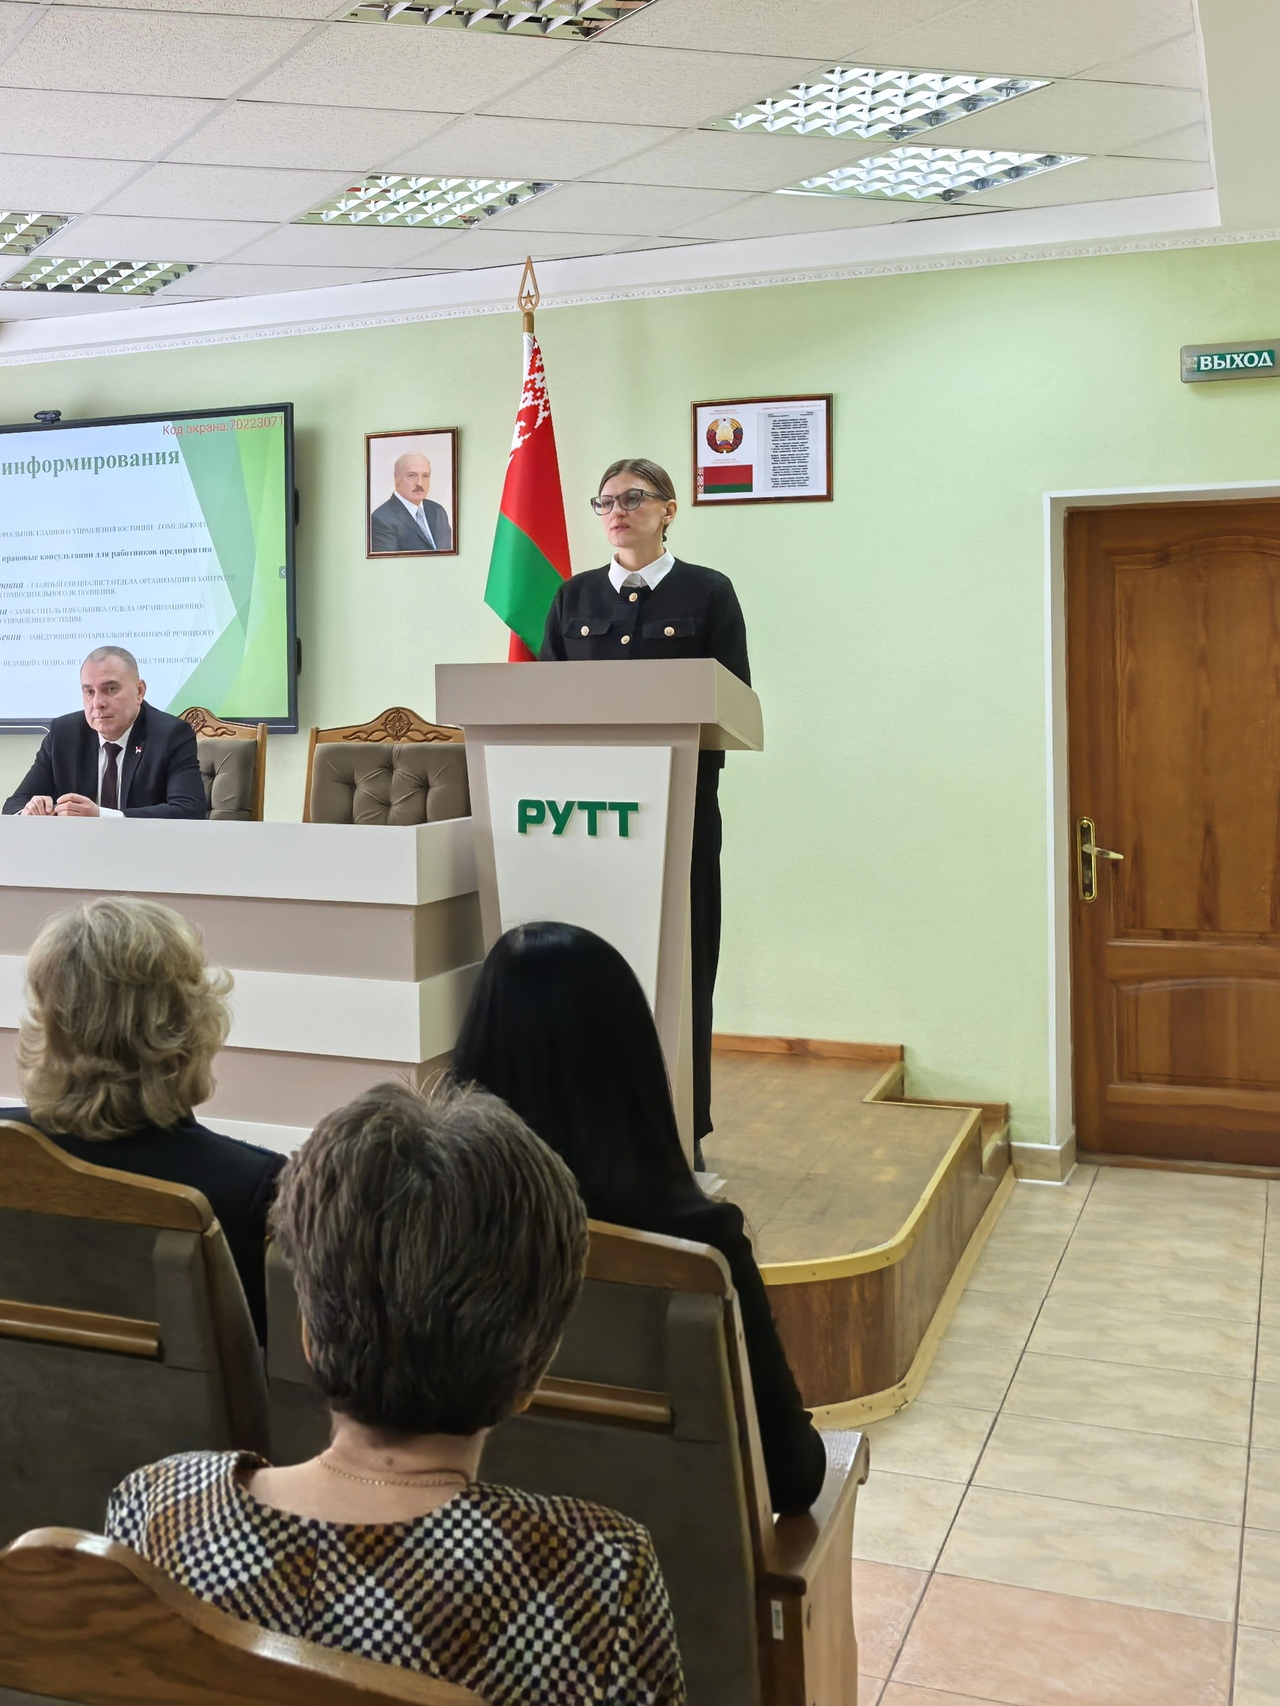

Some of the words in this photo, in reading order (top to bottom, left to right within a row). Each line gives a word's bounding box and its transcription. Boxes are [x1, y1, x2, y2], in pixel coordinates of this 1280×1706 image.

[1199, 351, 1273, 371] ВЫХОД
[163, 425, 184, 436] Код
[1, 450, 180, 479] информирования
[36, 528, 71, 536] ГЛАВНОГО
[72, 525, 116, 534] УПРАВЛЕНИЯ
[117, 524, 153, 532] ЮСТИЦИИ
[157, 521, 209, 530] ГОМЕЛЬСКОГО
[1, 554, 39, 563] правовые
[40, 552, 94, 562] консультации
[95, 550, 109, 559] для
[111, 548, 157, 559] работников
[30, 580, 63, 588] ГЛАВНЫЙ
[64, 578, 110, 587] СПЕЦИАЛИСТ
[110, 577, 138, 586] ОТДЕЛА
[138, 576, 190, 584] ОРГАНИЗАЦИИ
[198, 574, 236, 582] КОНТРОЛЯ
[3, 590, 68, 599] ПРИНУДИТЕЛЬНОГО
[14, 606, 61, 614] ЗАМЕСТИТЕЛЬ
[62, 605, 108, 613] НАЧАЛЬНИКА
[108, 604, 135, 612] ОТДЕЛА
[3, 616, 46, 624] УПРАВЛЕНИЯ
[29, 632, 77, 640] ЗАВЕДУЮЩИЙ
[78, 630, 133, 639] НОТАРИАЛЬНОЙ
[133, 629, 171, 638] КОНТОРОЙ
[172, 628, 214, 637] РЕЧИЦКОГО
[3, 659, 37, 667] ВЕДУЩИЙ
[37, 658, 82, 666] СПЕЦИАЛИСТ
[517, 799, 639, 837] РУТТ
